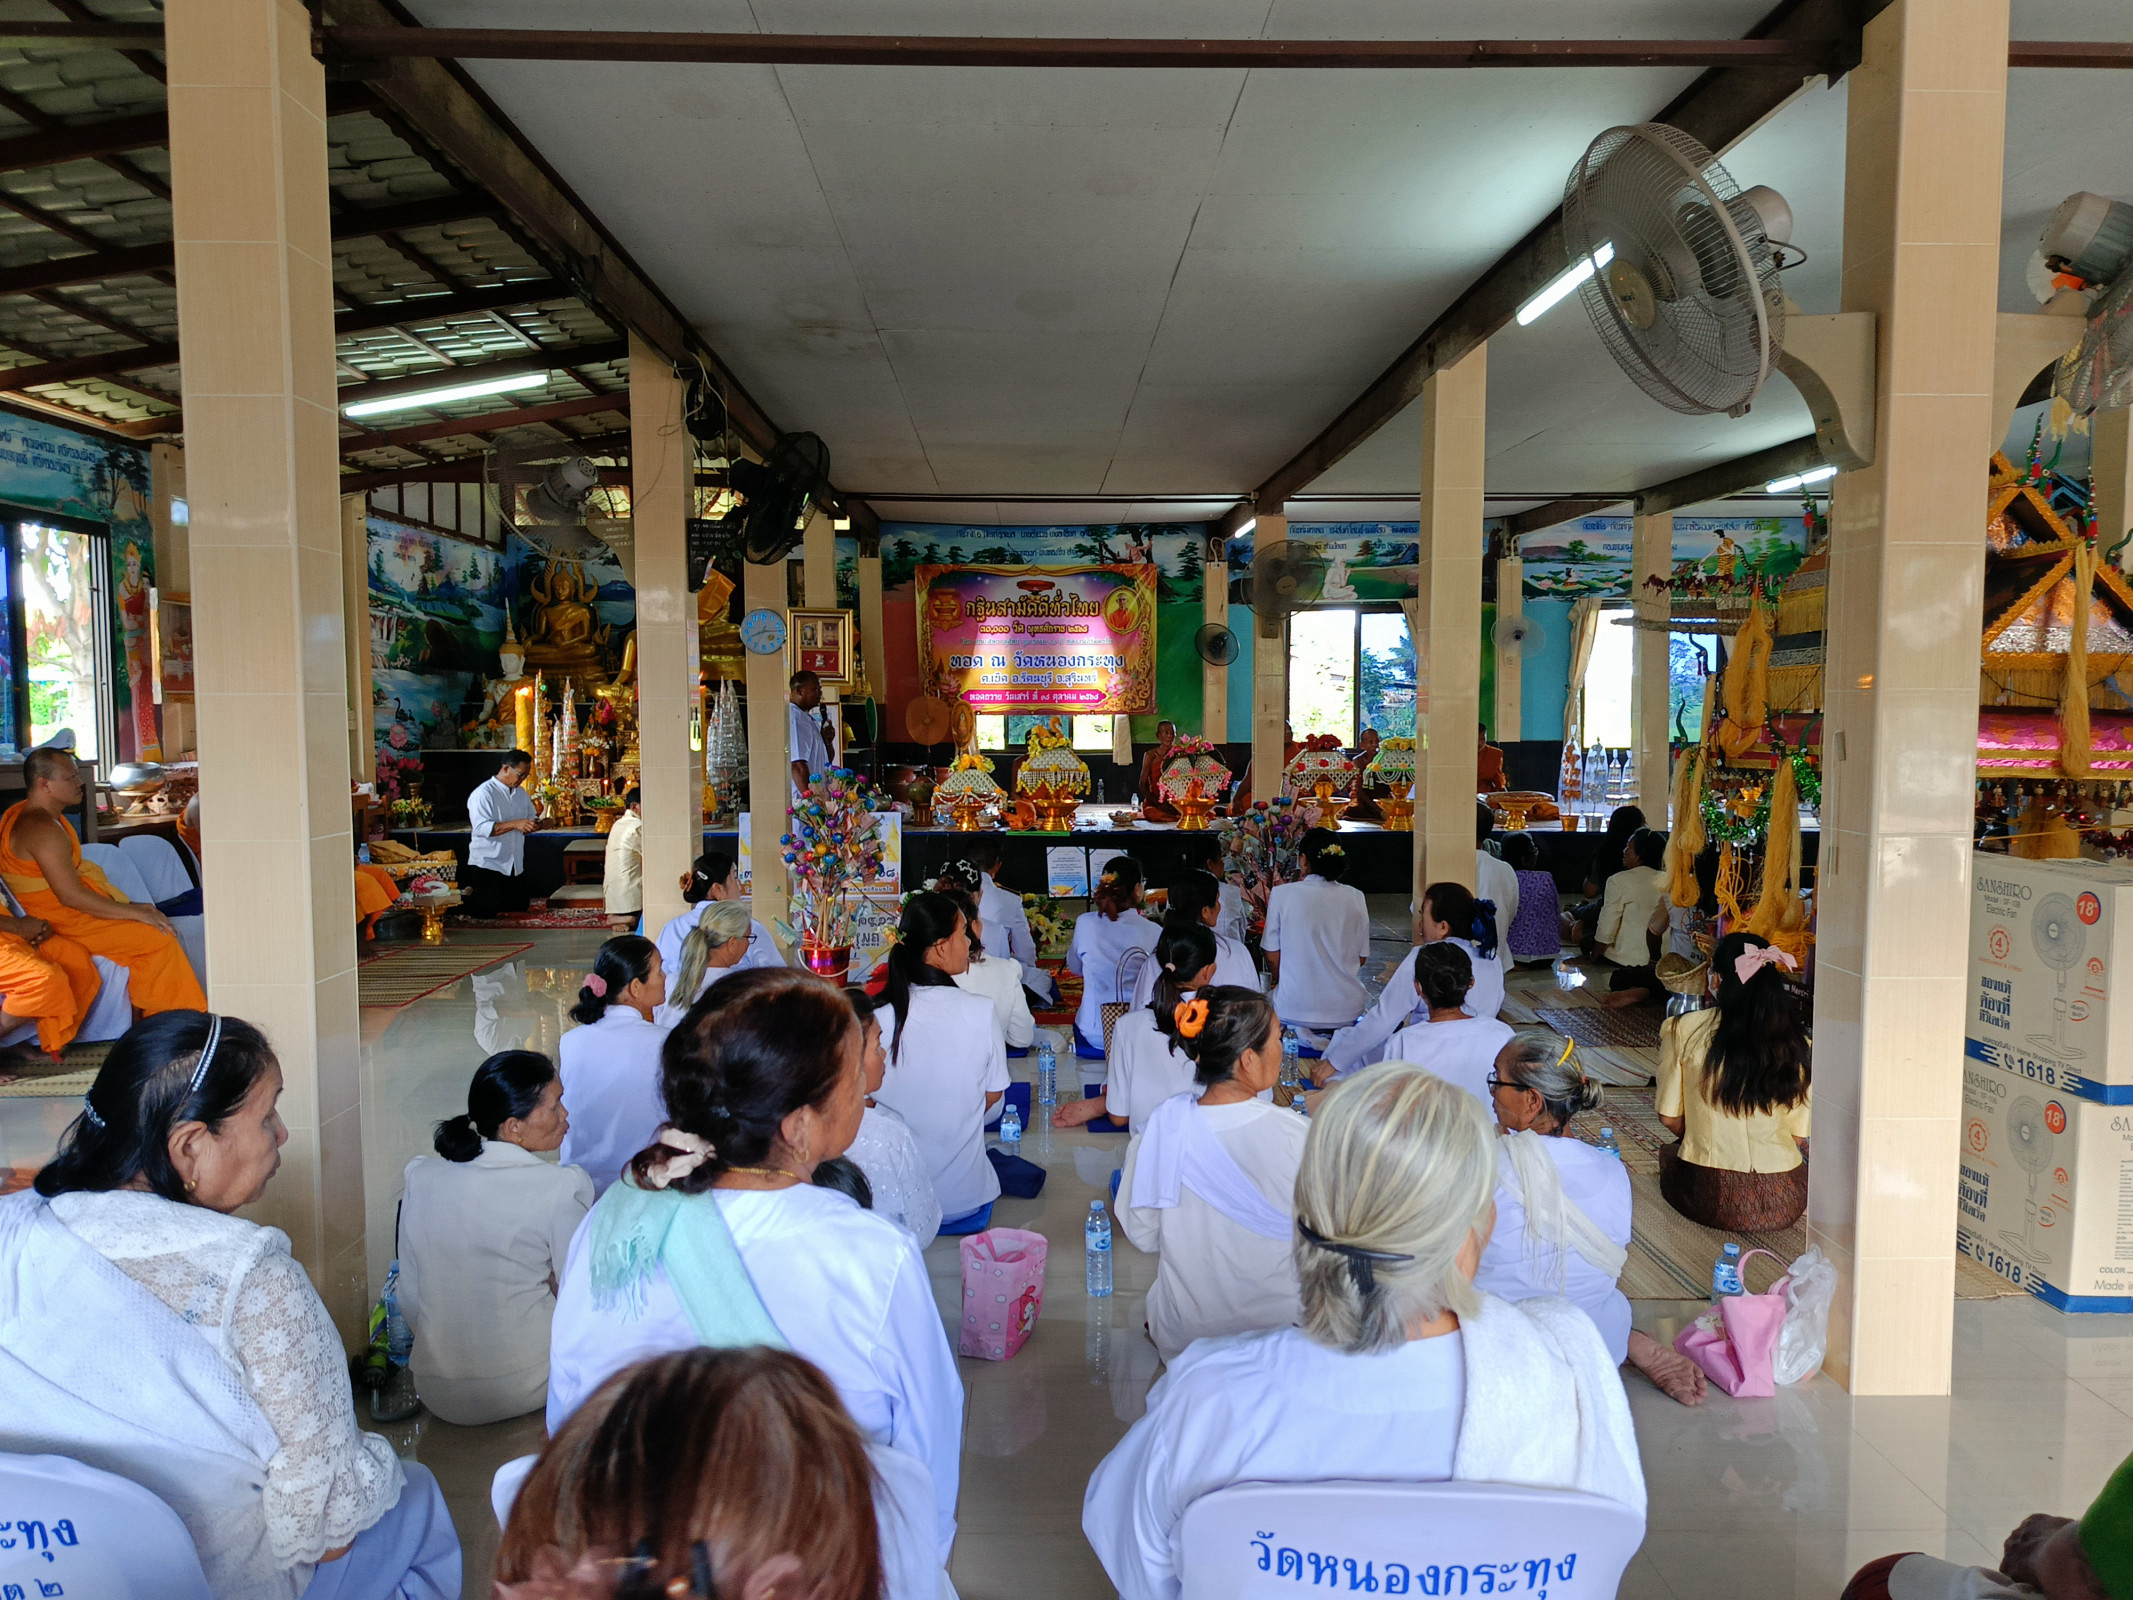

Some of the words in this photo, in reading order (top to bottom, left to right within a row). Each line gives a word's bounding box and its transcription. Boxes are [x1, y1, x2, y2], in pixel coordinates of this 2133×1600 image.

[965, 589, 1100, 622] กฐินสามัคคีทั่วไทย
[1012, 620, 1024, 633] วัด
[1027, 622, 1066, 637] พุทธศักราช
[950, 655, 984, 668] ทอด
[991, 655, 1006, 668] ณ
[1013, 650, 1124, 673] วัดหนองกระทุง
[1012, 671, 1052, 687] อ.รัตนบุรี
[1056, 671, 1098, 687] จ.สุรินทร์
[1005, 691, 1029, 701] วันเสาร์
[1053, 693, 1077, 704] ตุลาคม
[1977, 877, 2032, 900] SANSHIRO
[1986, 904, 2006, 916] Electric
[2007, 908, 2017, 919] Fan
[1995, 937, 2003, 948] 4
[2016, 1047, 2031, 1058] Home
[2032, 1052, 2056, 1068] Shopping
[2057, 1061, 2065, 1069] TV
[2017, 1057, 2055, 1085] 1618
[1974, 1130, 1981, 1142] 4
[1988, 1251, 2021, 1283] 1618
[2093, 1279, 2124, 1291] Made
[1250, 1530, 1576, 1600] วัดหนองกระทุง
[34, 1578, 64, 1598] ๒
